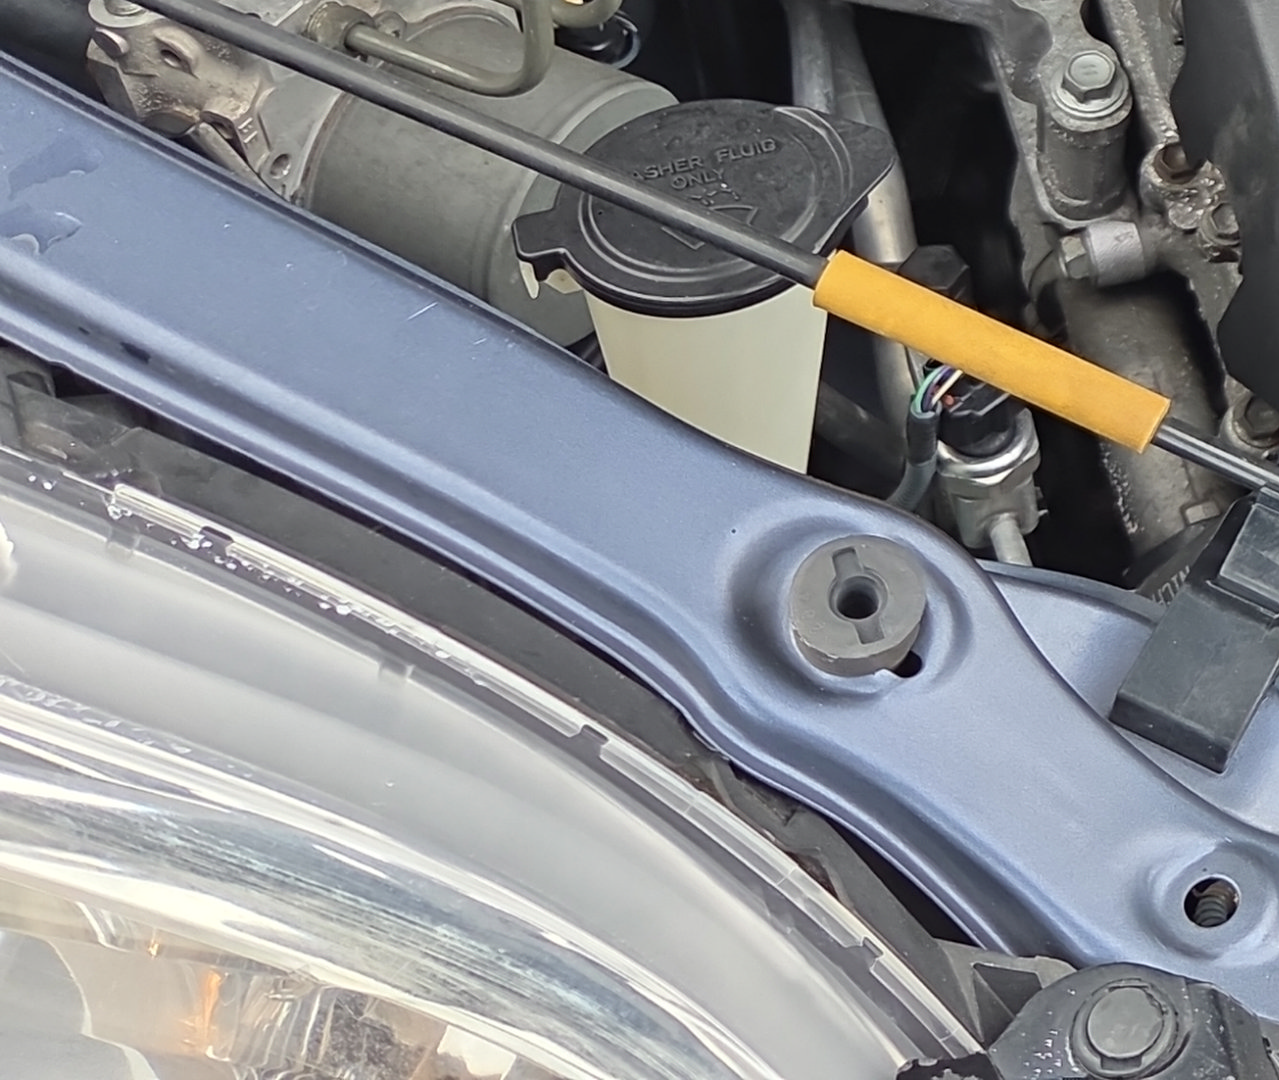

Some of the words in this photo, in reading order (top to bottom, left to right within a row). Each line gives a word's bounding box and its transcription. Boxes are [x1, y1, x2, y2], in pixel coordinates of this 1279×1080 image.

[631, 155, 705, 182] ASHER
[715, 137, 777, 164] FLUID
[670, 168, 726, 191] ONLY
